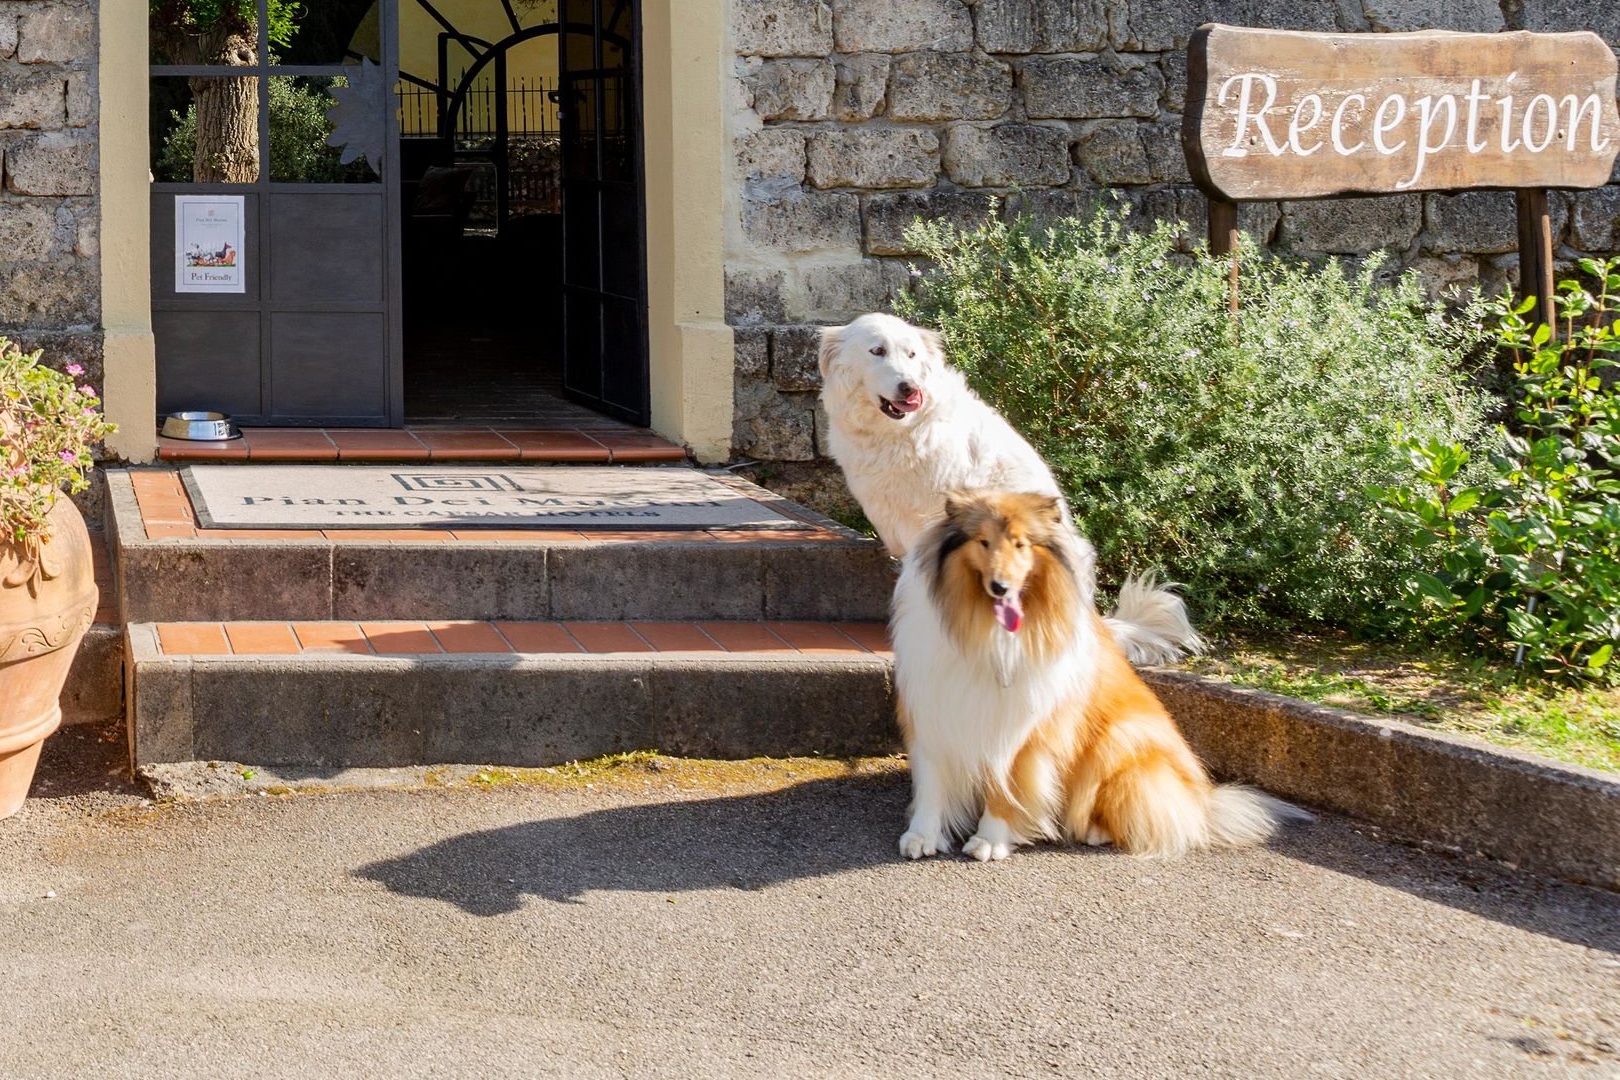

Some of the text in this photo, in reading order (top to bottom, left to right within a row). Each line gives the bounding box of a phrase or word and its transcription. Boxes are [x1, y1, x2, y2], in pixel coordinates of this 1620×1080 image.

[1217, 71, 1611, 189] Reception
[191, 272, 232, 282] Pet Friendly
[241, 496, 367, 506] Pian
[393, 496, 492, 506] Dei
